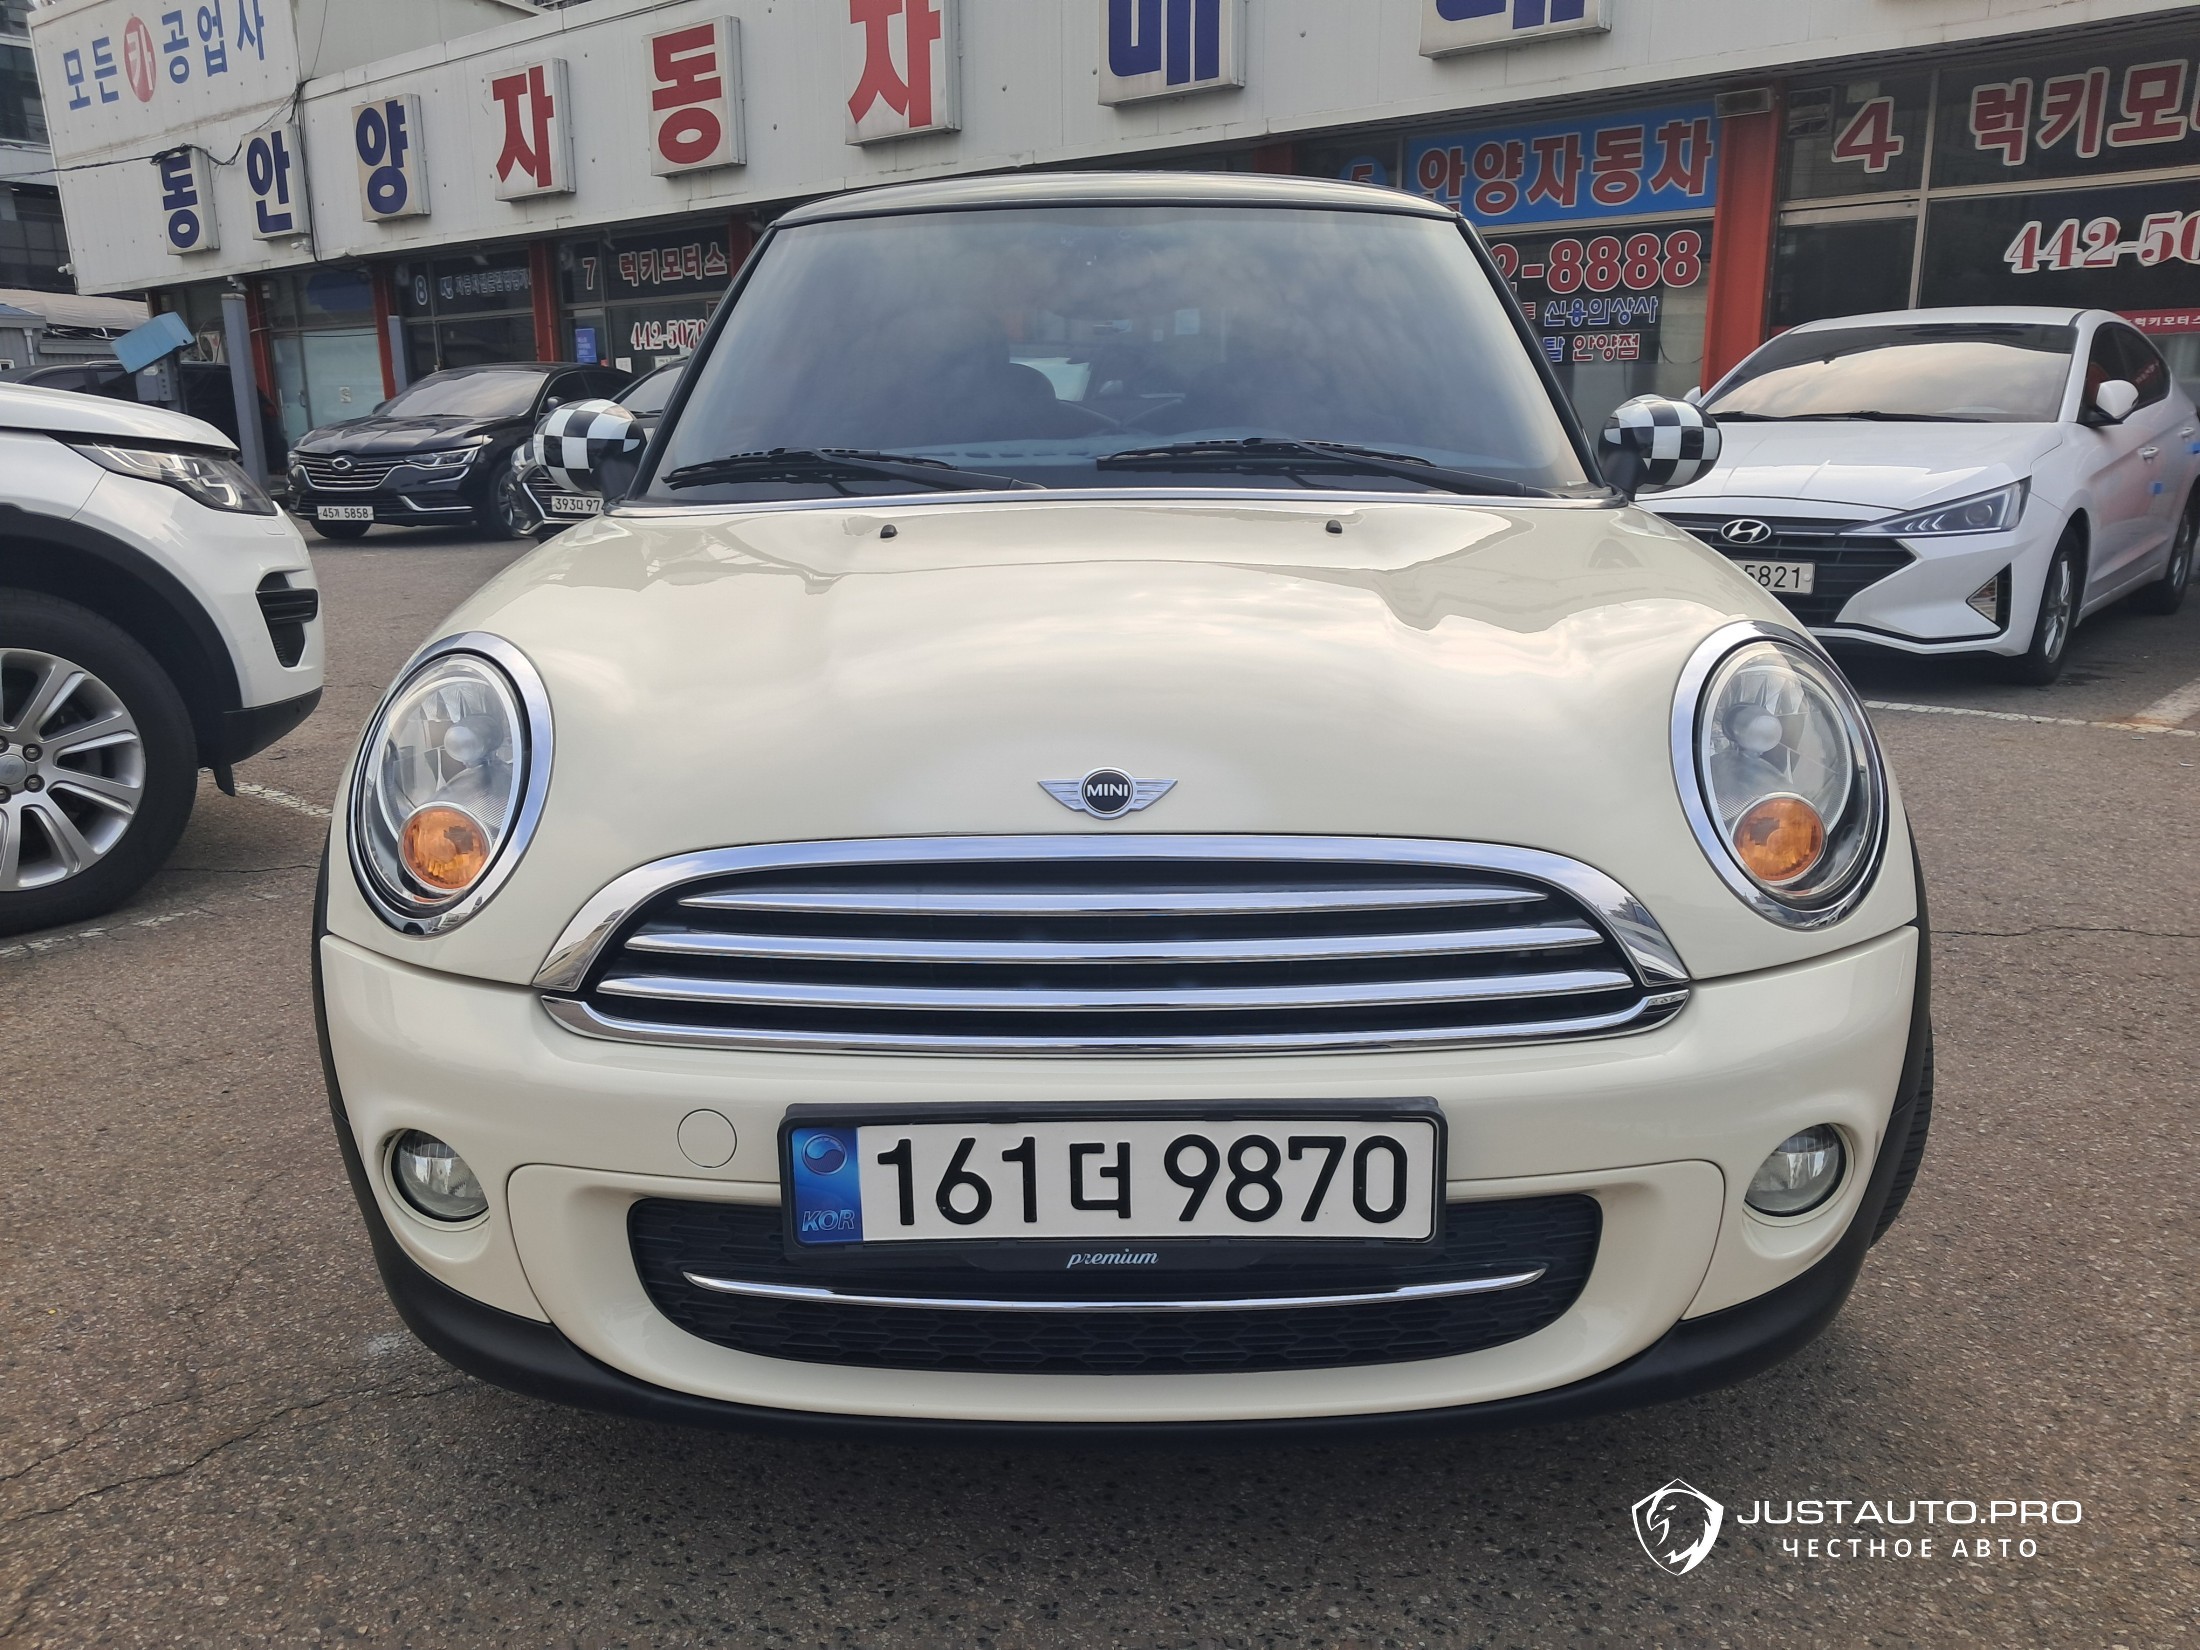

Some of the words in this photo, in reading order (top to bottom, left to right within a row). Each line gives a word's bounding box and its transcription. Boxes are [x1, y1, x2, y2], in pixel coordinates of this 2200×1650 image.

[1970, 59, 2200, 166] 럭키모
[1832, 96, 1904, 173] 4
[1417, 117, 1713, 216] 안양자동차
[583, 257, 596, 290] 7
[619, 242, 727, 287] 럭키모터스
[415, 275, 428, 305] 8
[1572, 333, 1640, 362] 안양점
[344, 508, 369, 518] 5858
[1086, 783, 1128, 797] MINI
[877, 1136, 1131, 1226] 161더
[1163, 1133, 1408, 1224] 9870
[801, 1209, 855, 1232] KOR
[1066, 1248, 1159, 1269] premium
